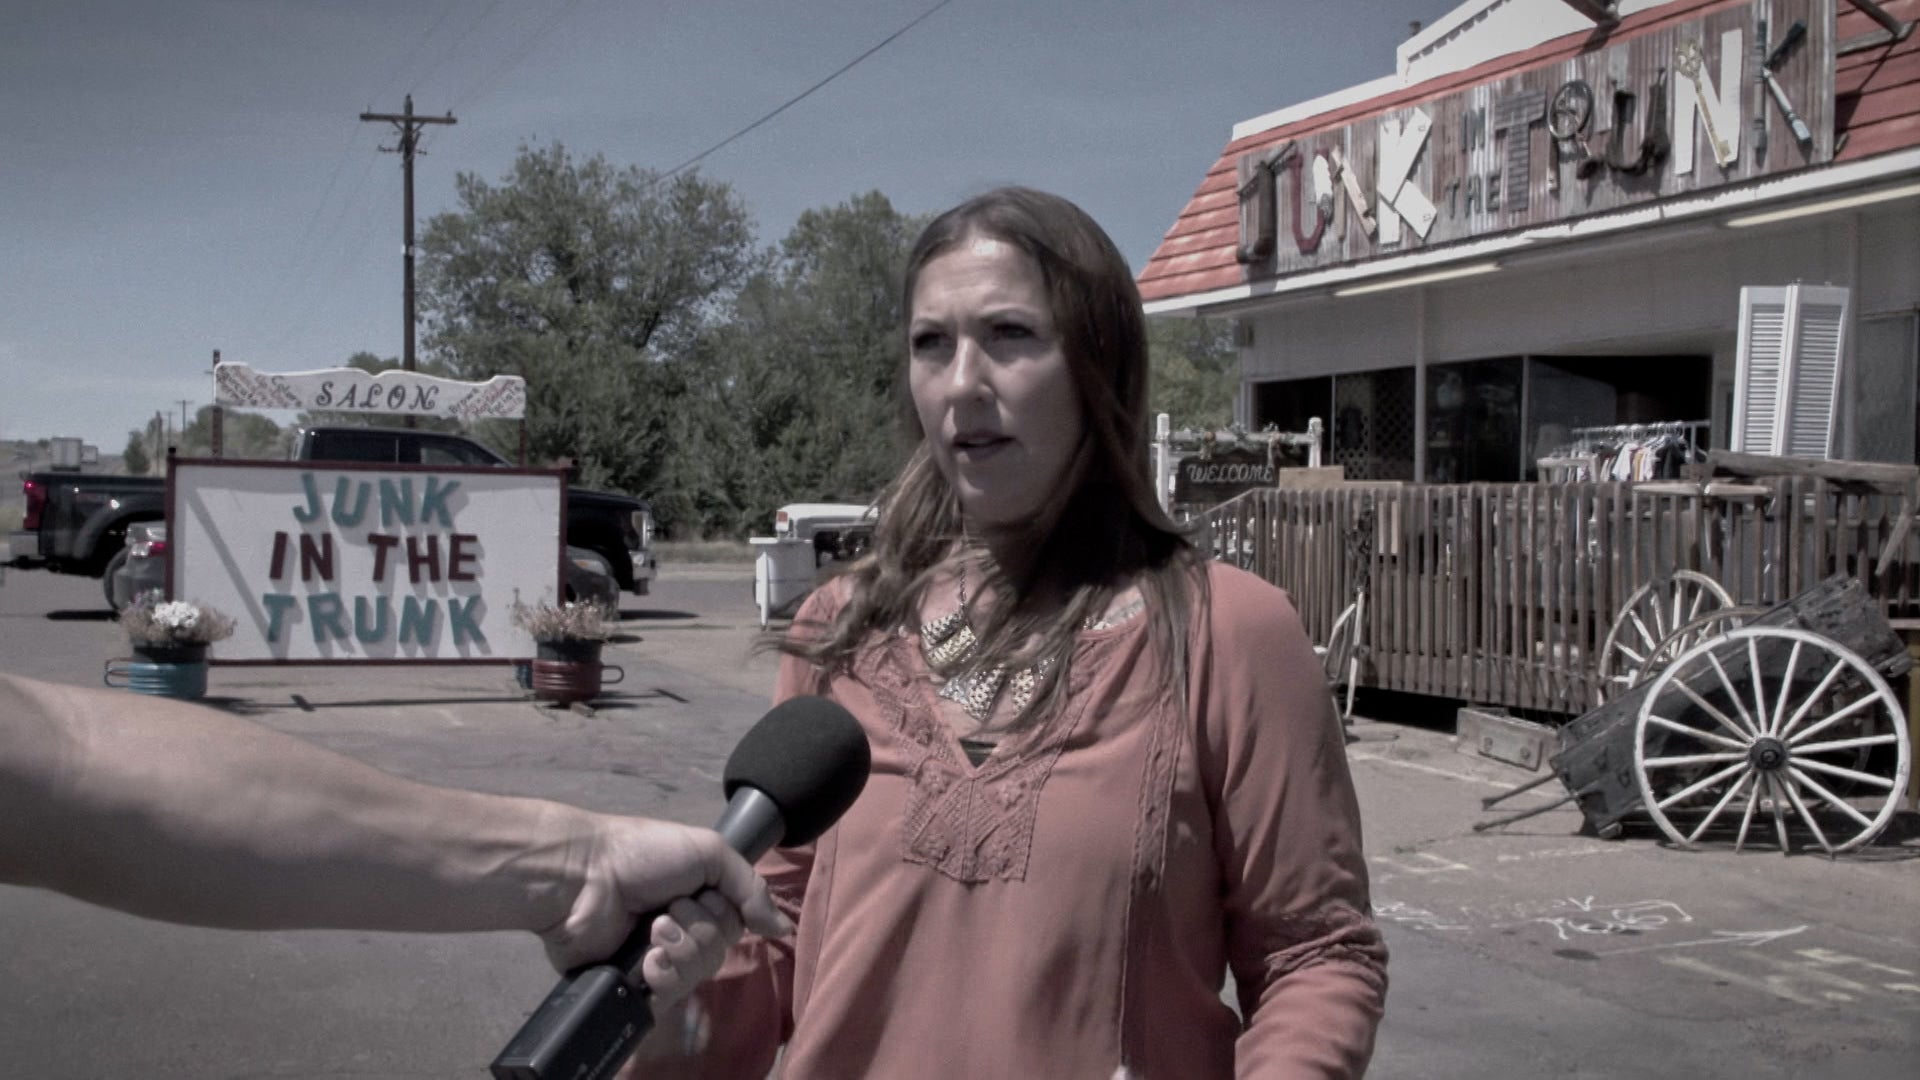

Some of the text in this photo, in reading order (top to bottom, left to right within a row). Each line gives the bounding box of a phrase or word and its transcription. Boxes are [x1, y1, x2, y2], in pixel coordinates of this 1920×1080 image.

[1237, 20, 1813, 263] JUNK IN THE TRUNK
[316, 381, 439, 410] SALON
[293, 473, 461, 527] JUNK
[1186, 463, 1274, 484] WELCOME
[269, 531, 477, 583] IN THE
[263, 593, 488, 647] TRUNK
